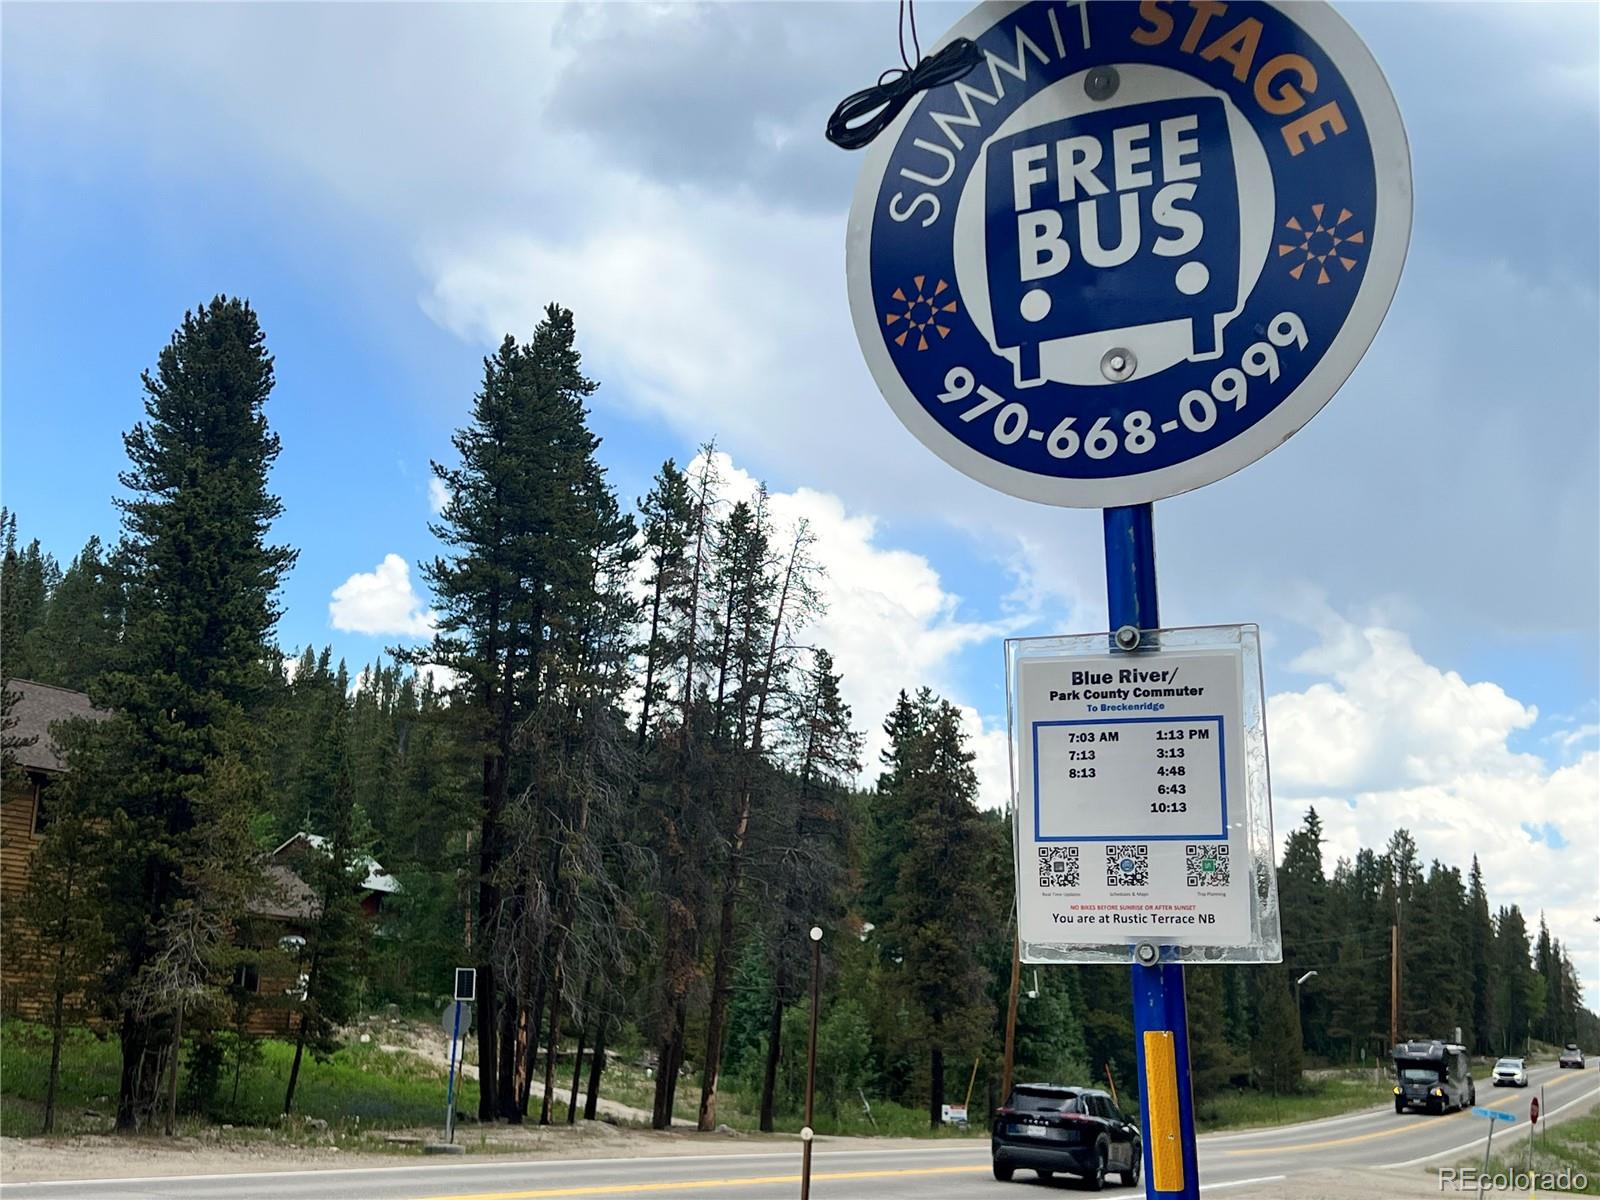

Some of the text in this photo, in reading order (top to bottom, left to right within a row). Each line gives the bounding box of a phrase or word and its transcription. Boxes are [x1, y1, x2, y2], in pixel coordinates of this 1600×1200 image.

[889, 0, 1348, 228] SUMMIT STAGE
[1012, 114, 1201, 212] FREE
[1018, 183, 1204, 281] BUS
[936, 311, 1310, 460] 970-668-0999
[1071, 667, 1179, 686] Blue River/
[1049, 686, 1204, 701] Park County Commuter
[1086, 702, 1165, 712] To Breckenridge
[1068, 731, 1119, 743] 7:03 AM
[1156, 729, 1209, 740] 1:13 PM
[1068, 750, 1096, 760] 7:13
[1156, 748, 1185, 758] 3:13
[1068, 768, 1096, 778] 8:13
[1157, 766, 1186, 776] 4:48
[1157, 784, 1186, 794] 6:43
[1150, 802, 1187, 813] 10:13
[1052, 913, 1216, 924] You are at Rustic Terrace NB
